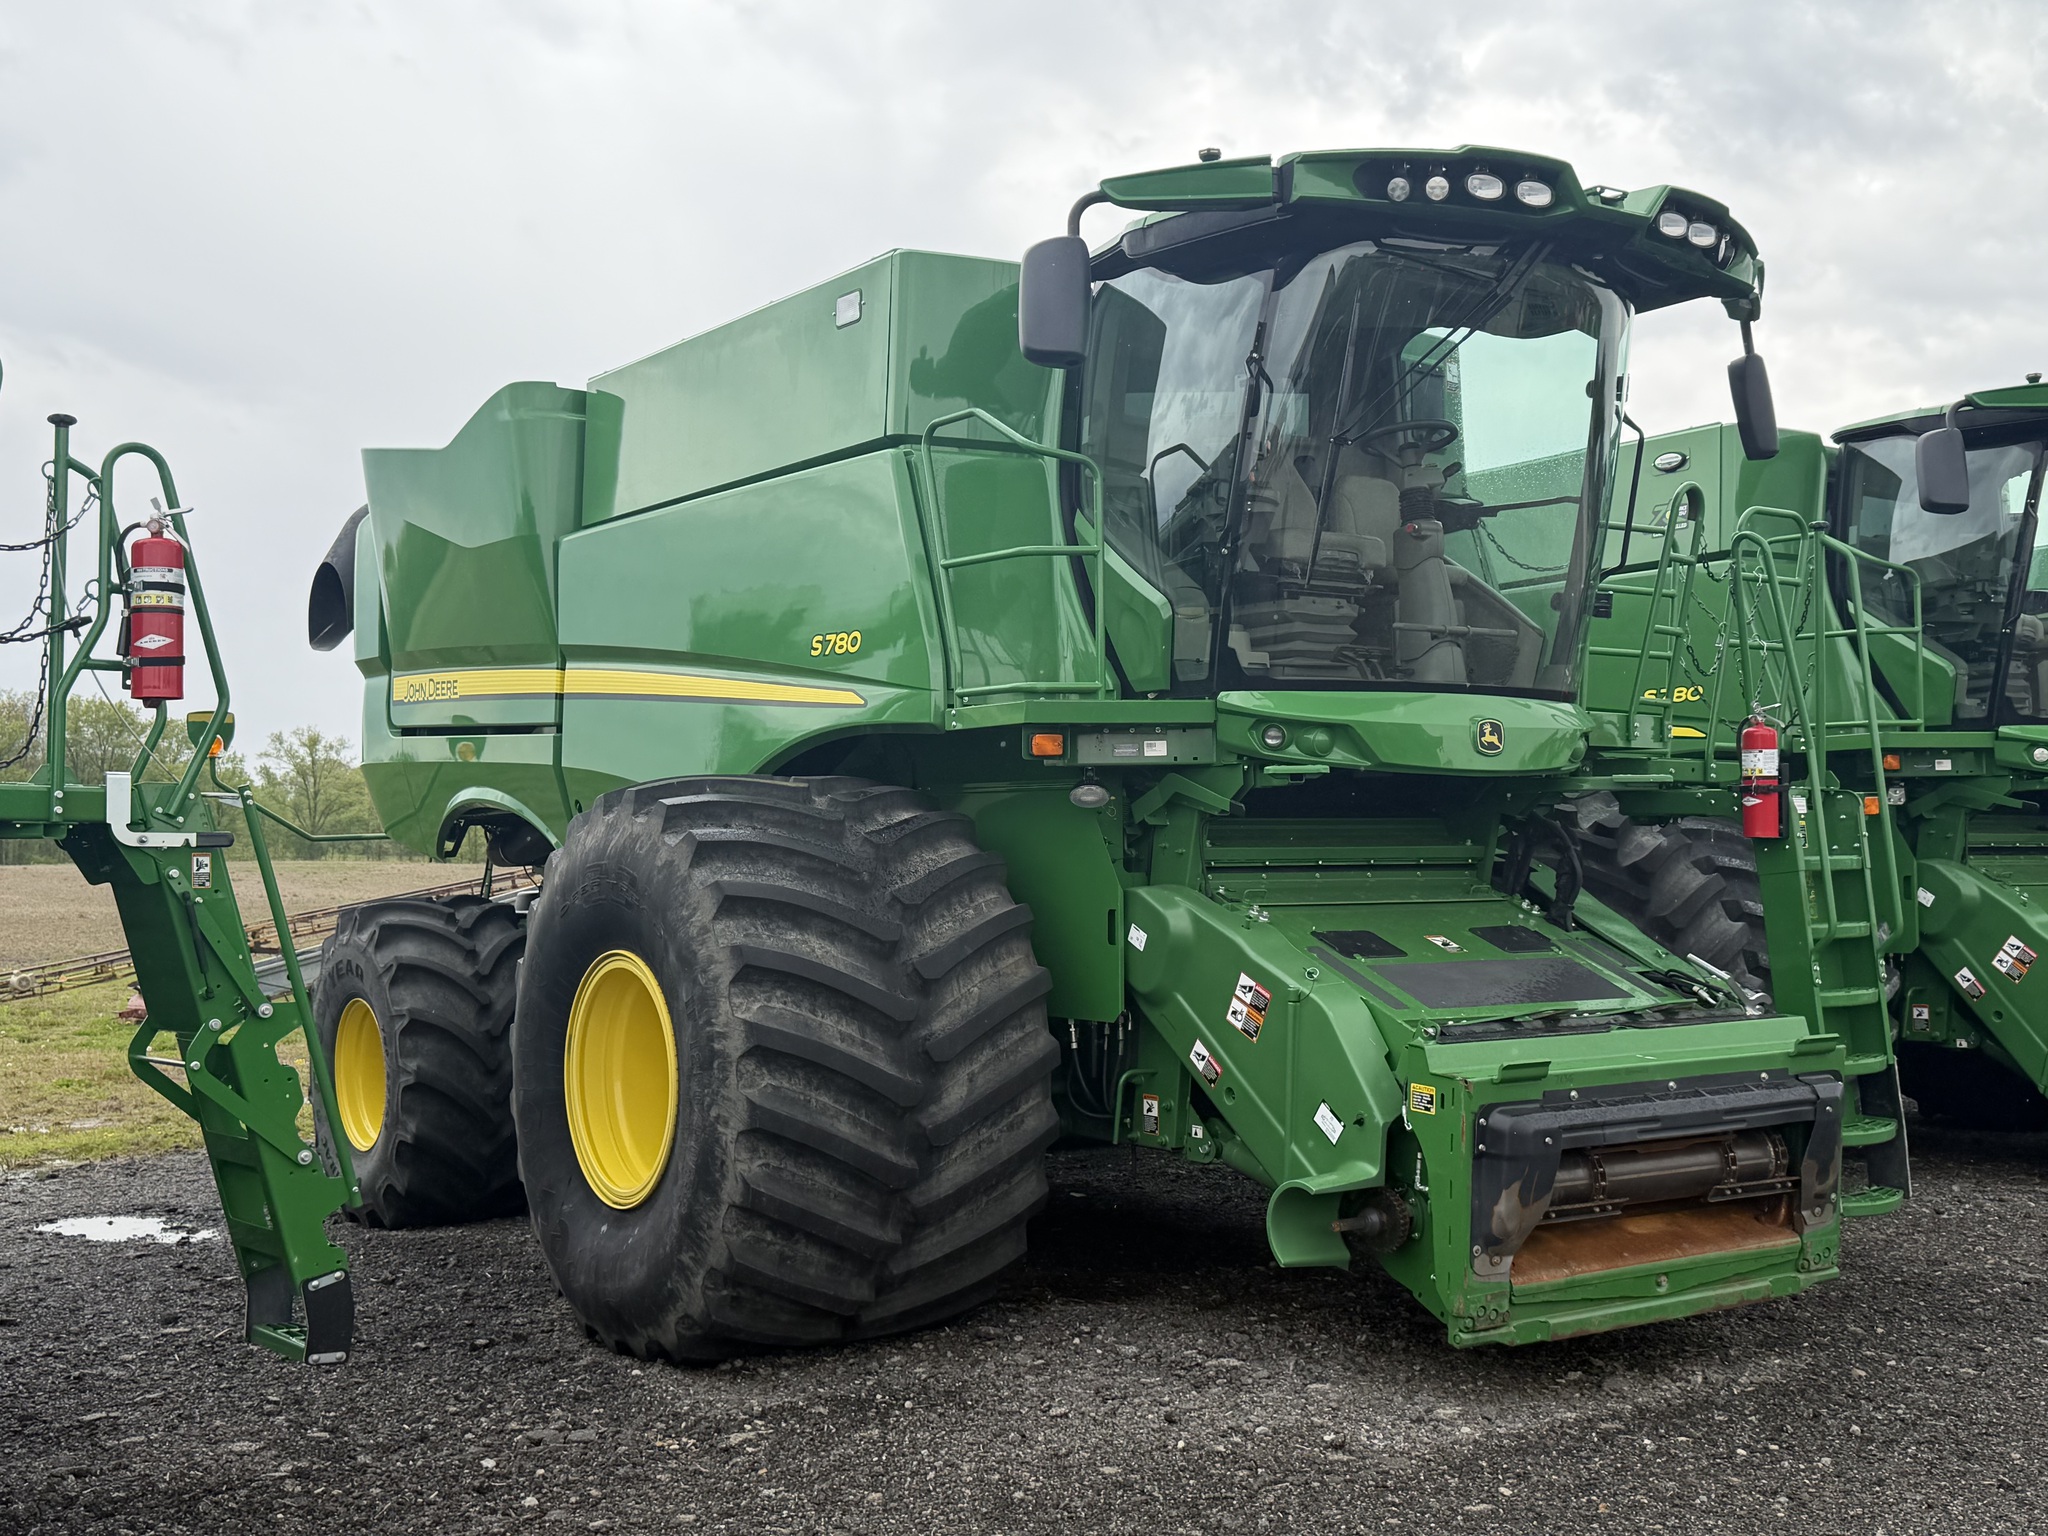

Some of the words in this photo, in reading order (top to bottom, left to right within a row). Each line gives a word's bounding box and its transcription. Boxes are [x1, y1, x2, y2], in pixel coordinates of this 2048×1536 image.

[810, 630, 862, 657] S780
[404, 681, 427, 700] JOHN
[428, 678, 459, 697] DEERE
